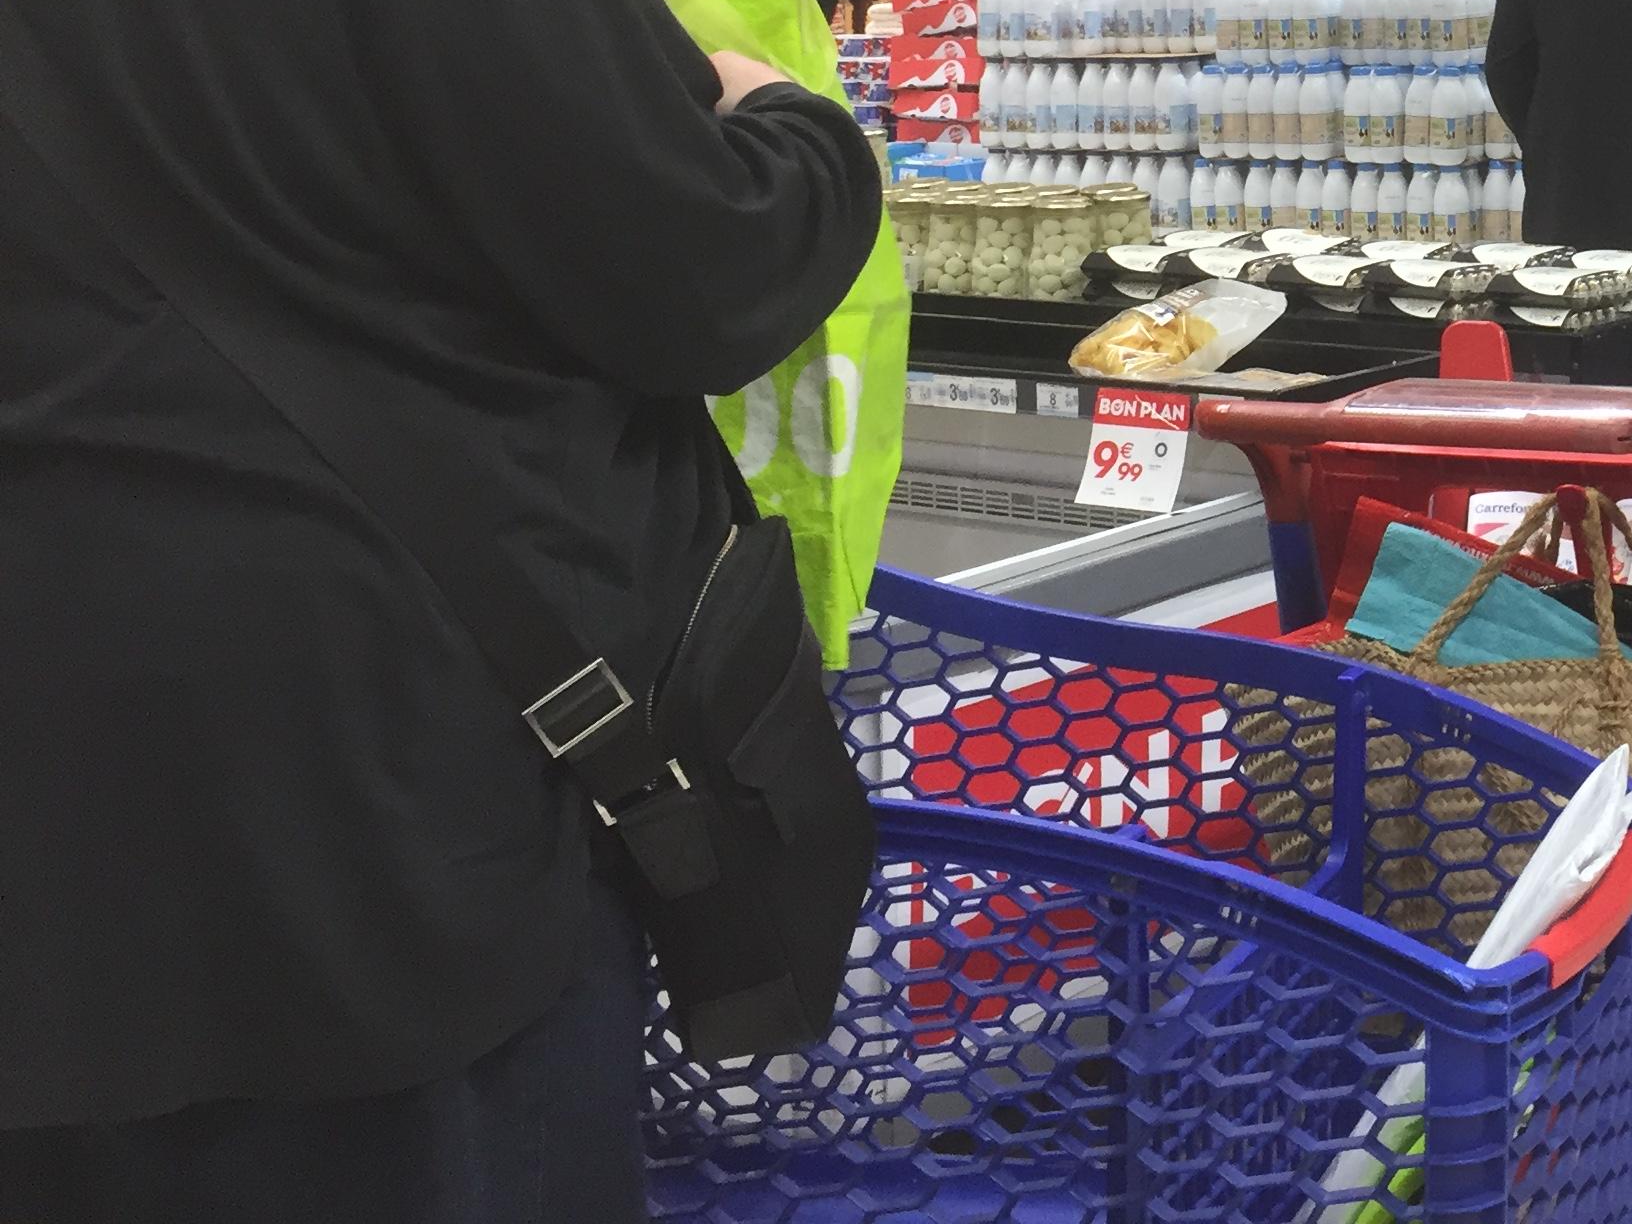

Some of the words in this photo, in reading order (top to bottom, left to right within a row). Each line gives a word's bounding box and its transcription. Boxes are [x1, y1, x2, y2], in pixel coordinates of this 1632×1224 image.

[1098, 397, 1137, 417] BON
[1140, 400, 1185, 422] PLAN
[1475, 503, 1531, 514] Carrefo
